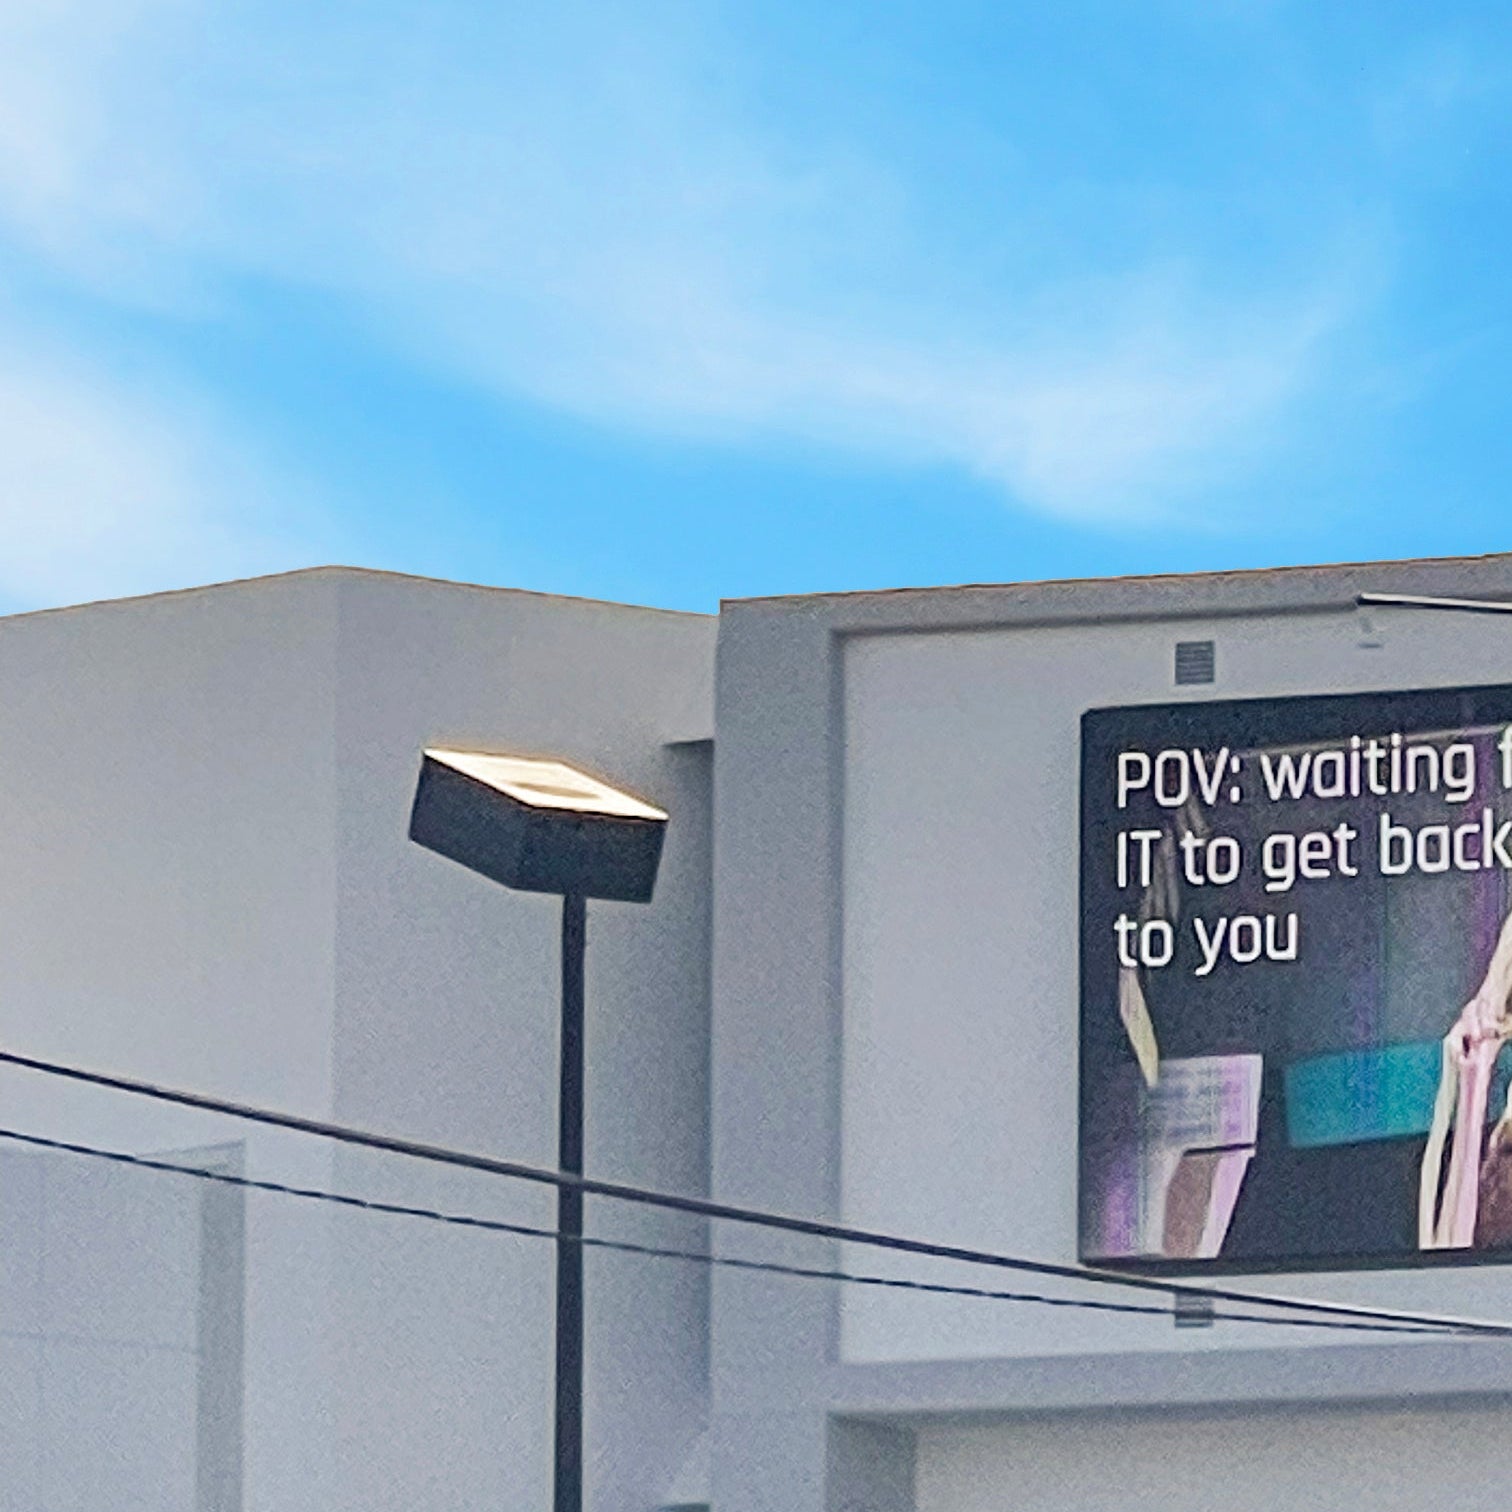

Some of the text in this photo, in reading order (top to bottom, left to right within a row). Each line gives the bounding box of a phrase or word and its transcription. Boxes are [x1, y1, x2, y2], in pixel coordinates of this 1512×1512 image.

[1116, 747, 1242, 809] POV:
[1260, 733, 1476, 802] waiting
[1116, 829, 1162, 888] IT
[1180, 831, 1241, 886] to
[1261, 822, 1358, 893] get
[1114, 913, 1299, 977] to you
